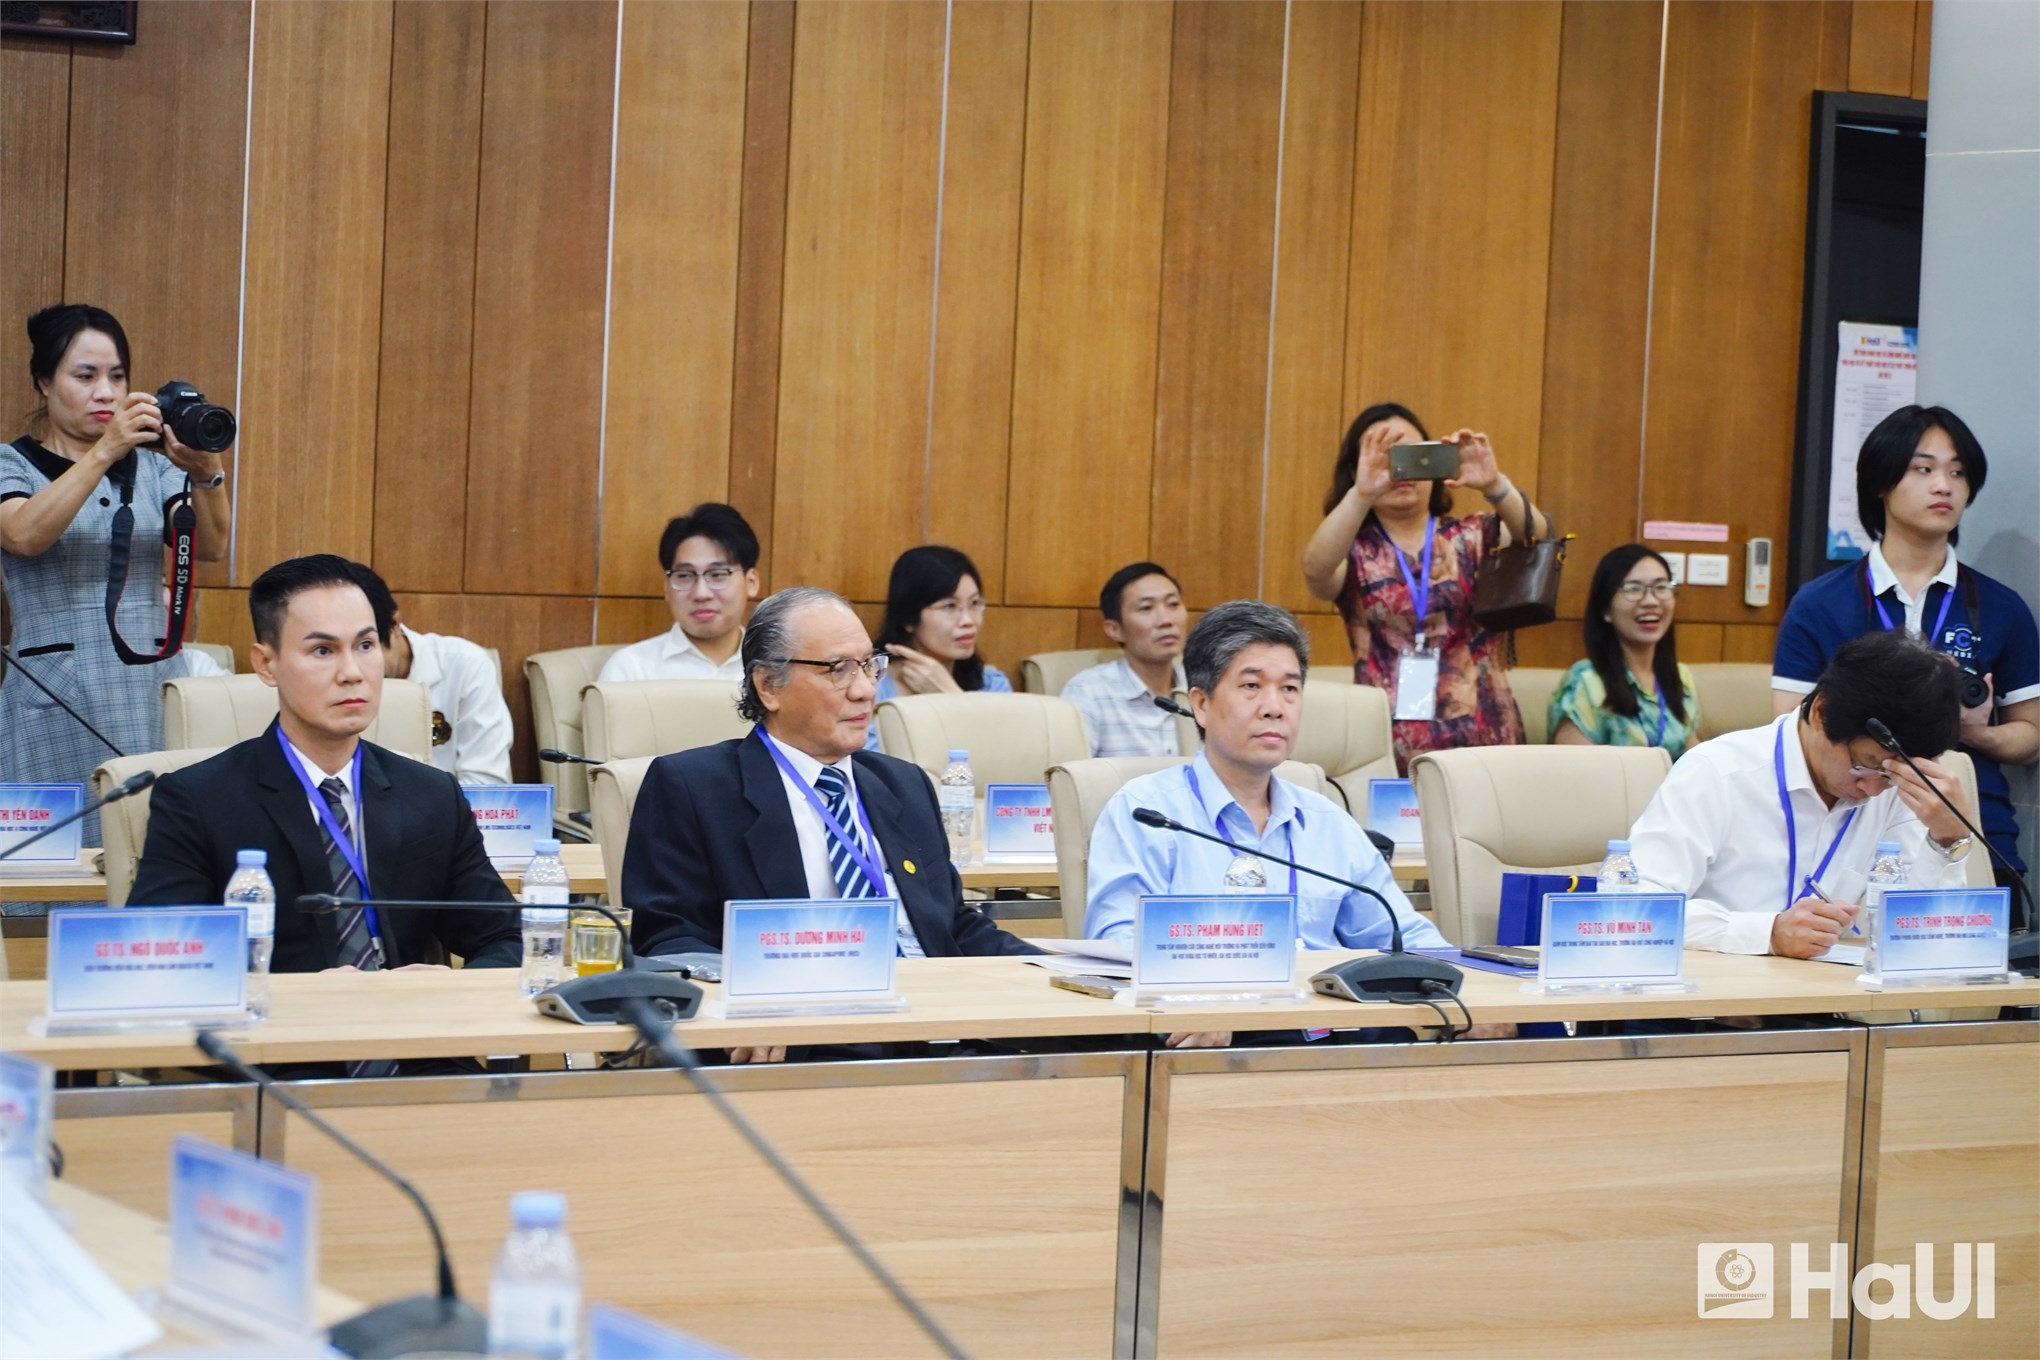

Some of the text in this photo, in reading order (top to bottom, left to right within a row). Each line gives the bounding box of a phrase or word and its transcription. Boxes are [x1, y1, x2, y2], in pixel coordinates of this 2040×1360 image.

[178, 534, 190, 566] EOS
[1197, 923, 1221, 940] PHẠM
[1247, 921, 1264, 939] VIỆT
[1618, 922, 1637, 934] MINH
[826, 930, 849, 944] MINH
